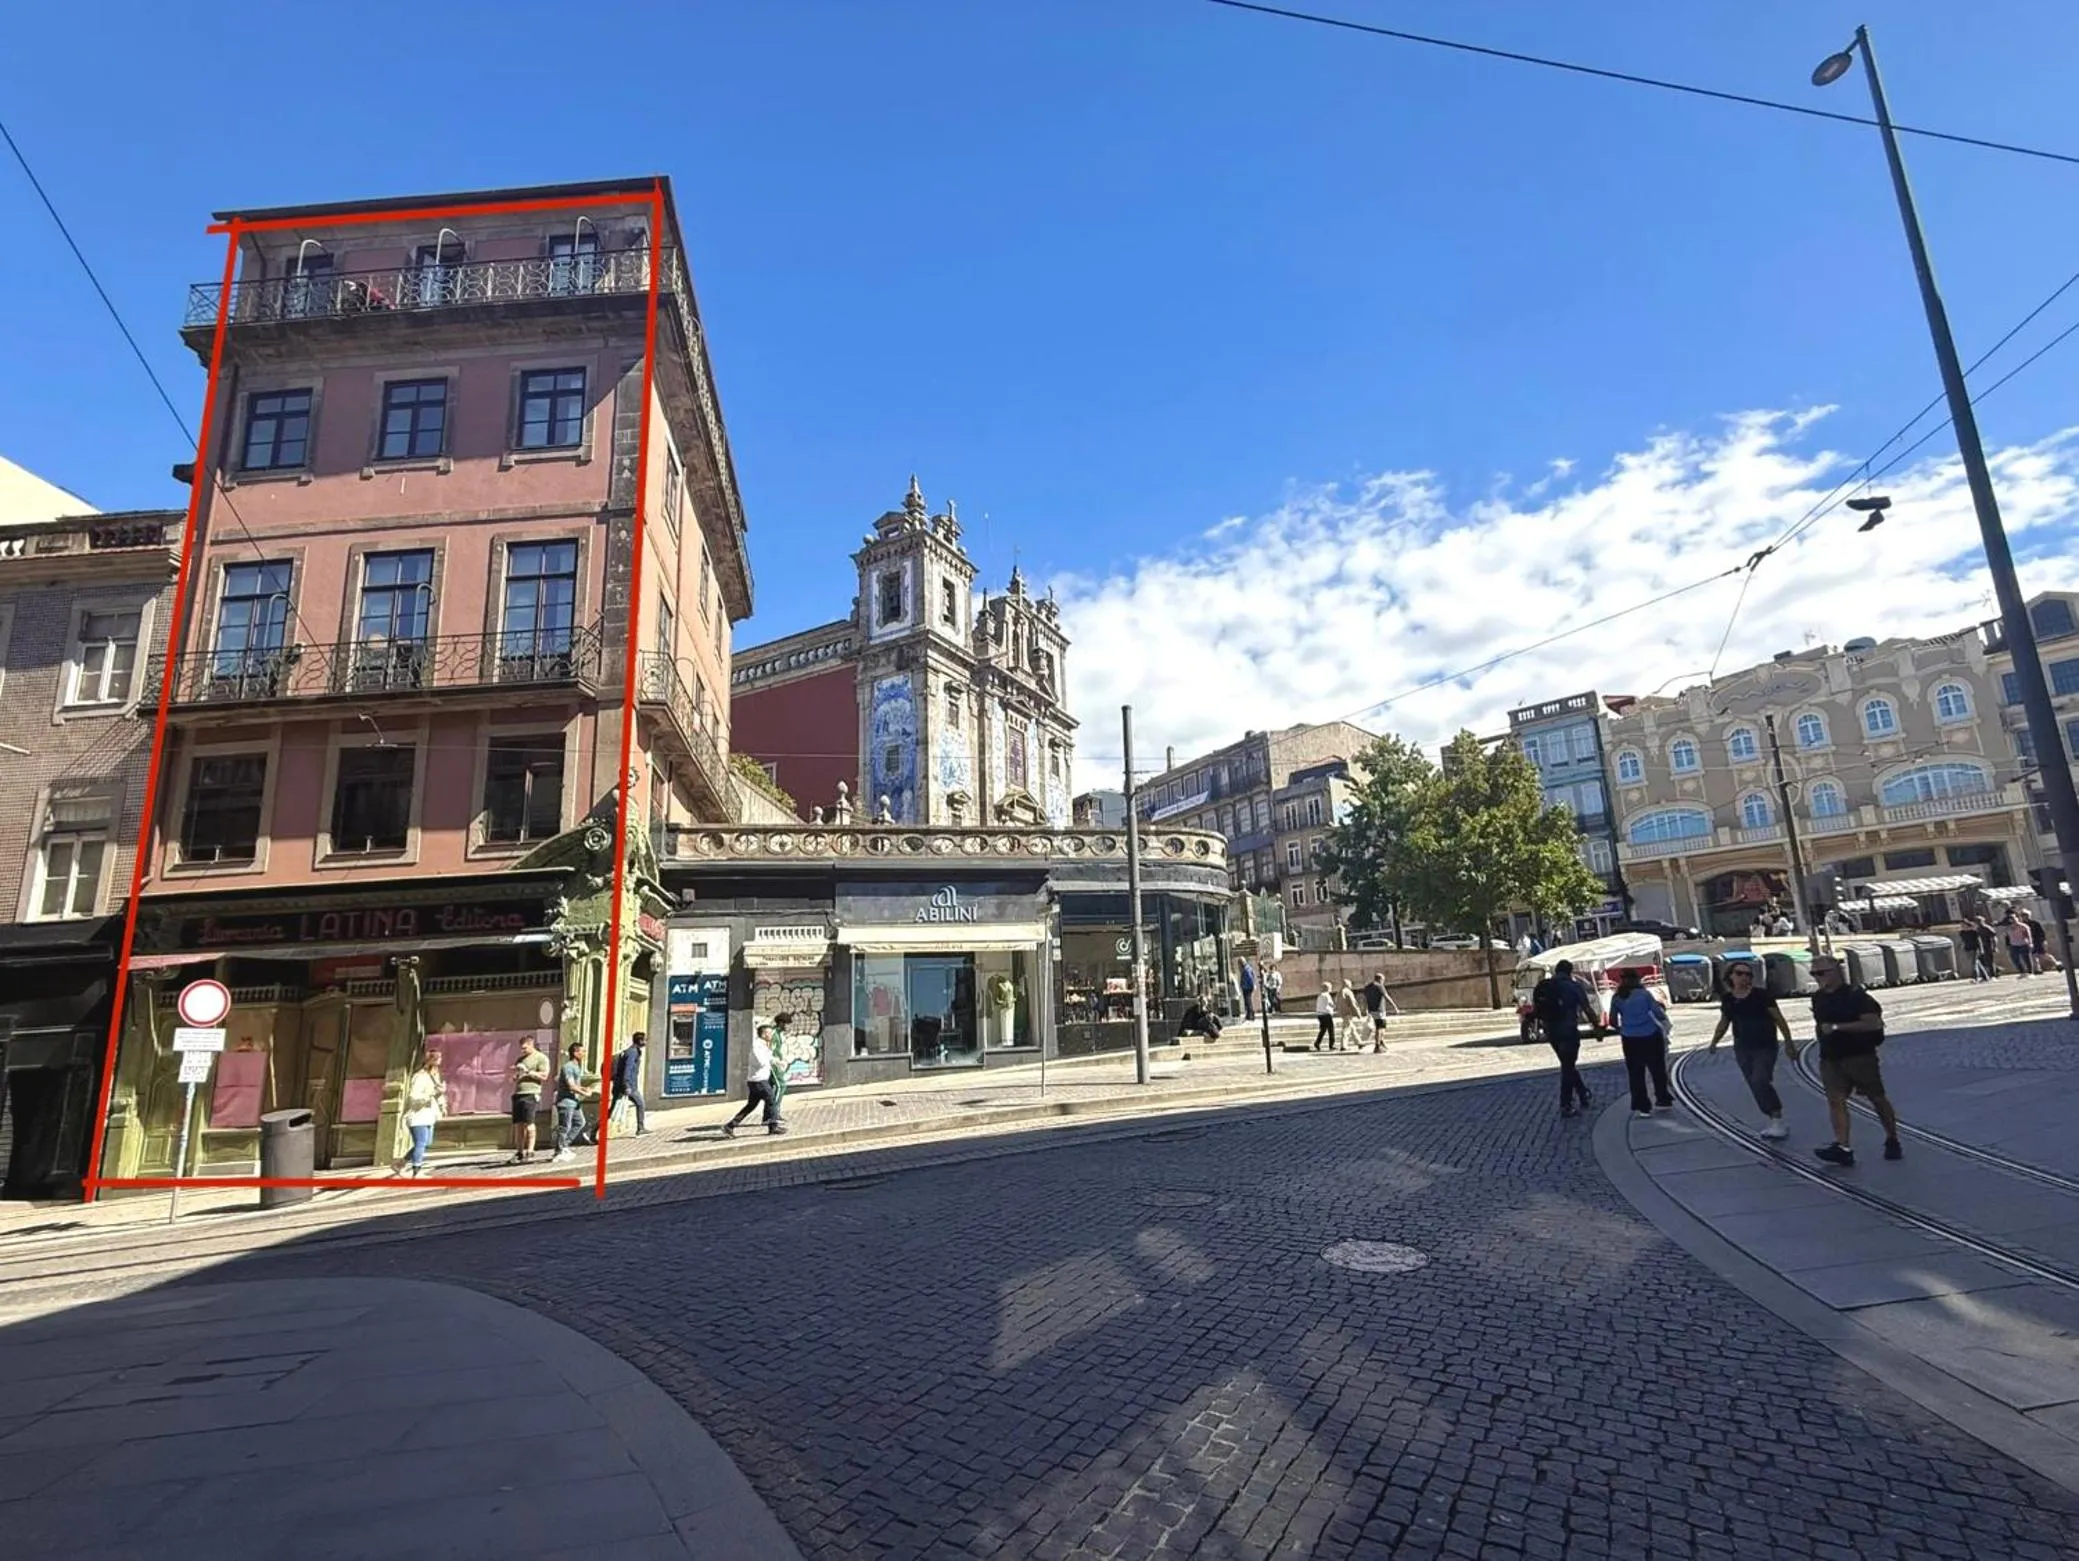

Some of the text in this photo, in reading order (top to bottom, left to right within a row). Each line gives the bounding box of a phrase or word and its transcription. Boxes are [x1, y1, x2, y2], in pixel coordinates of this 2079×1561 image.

[915, 905, 977, 921] ABILINI
[300, 908, 418, 941] LATINA
[672, 984, 698, 994] ATM
[704, 980, 727, 990] ATM
